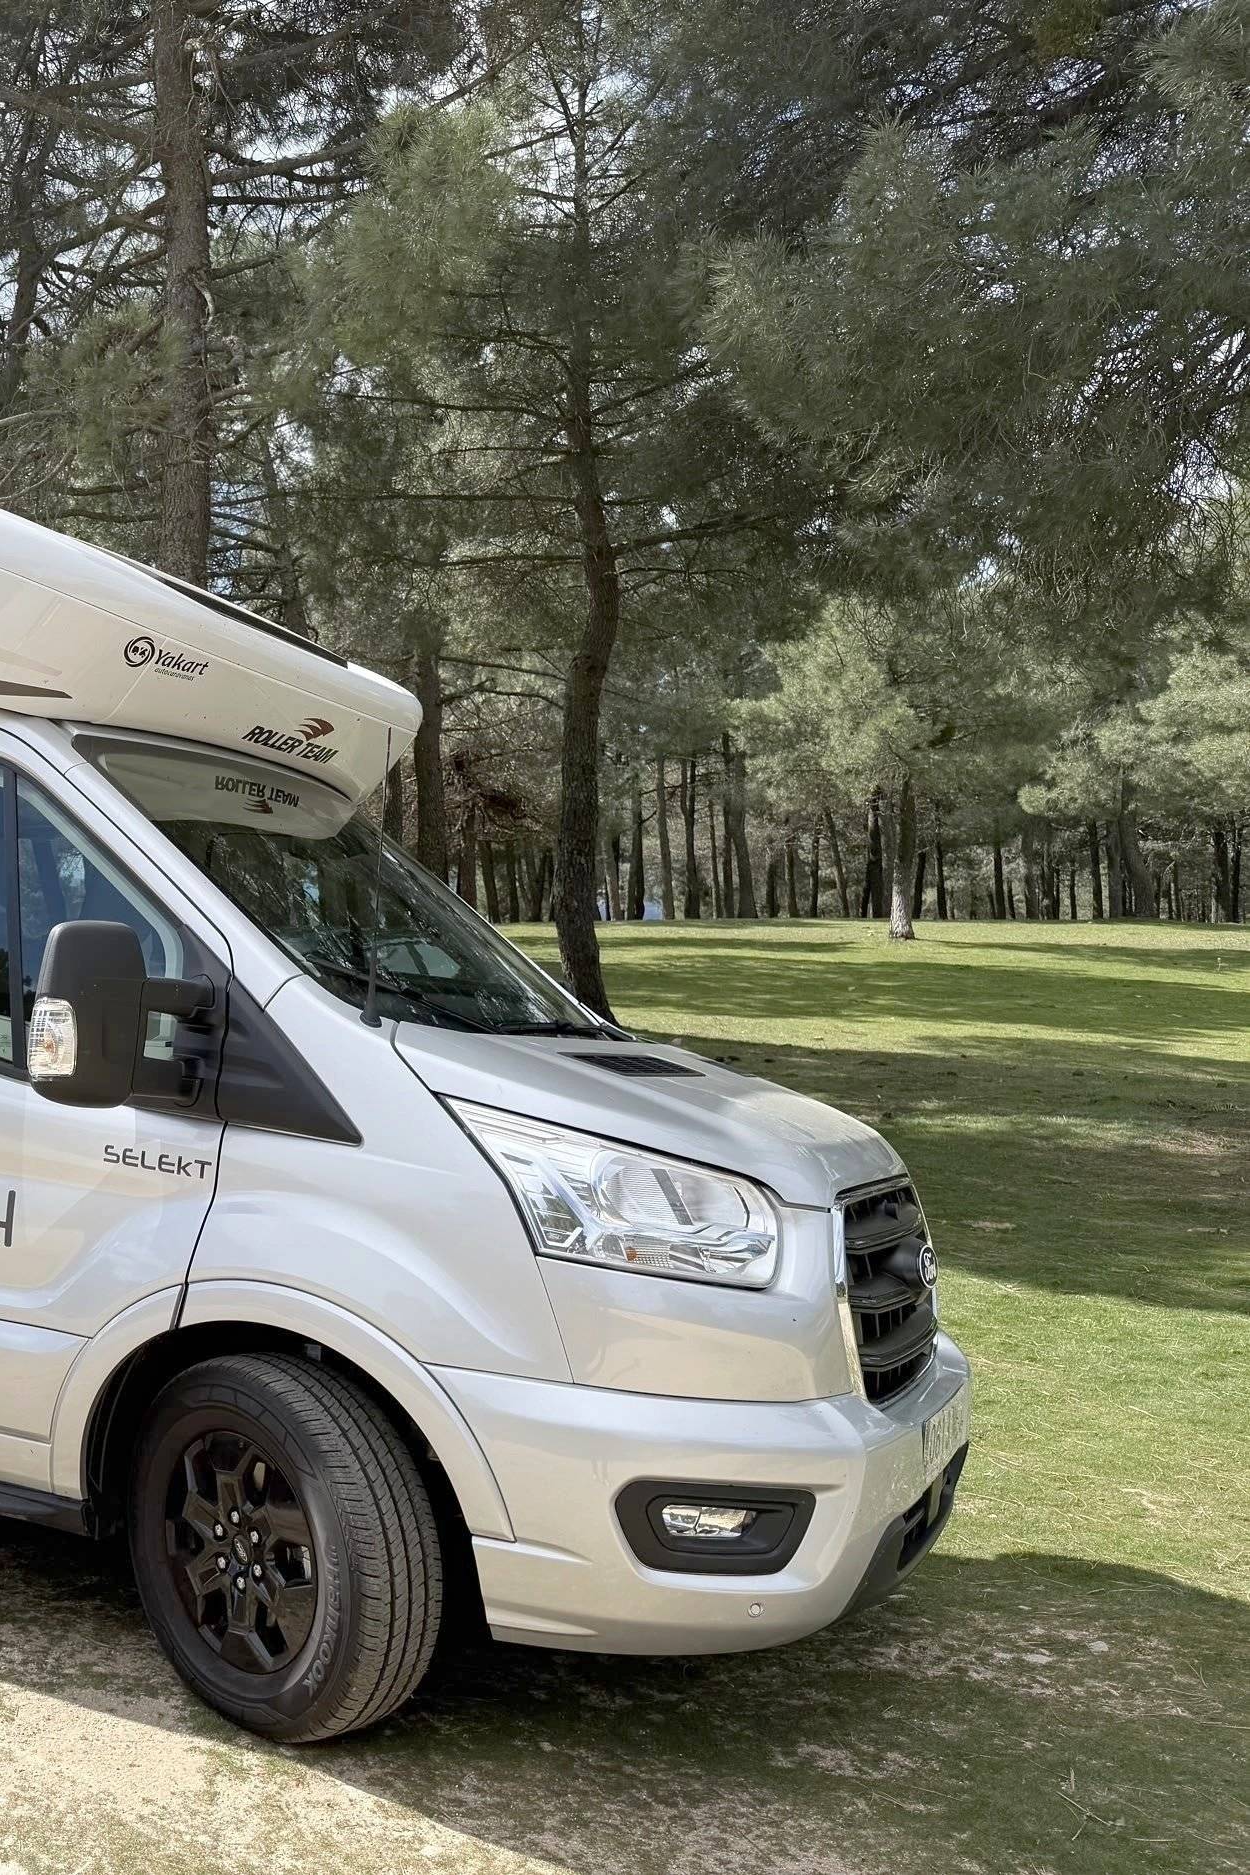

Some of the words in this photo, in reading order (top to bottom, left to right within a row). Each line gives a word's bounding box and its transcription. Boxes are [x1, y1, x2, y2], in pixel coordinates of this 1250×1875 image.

[155, 649, 209, 675] Yakart
[241, 725, 304, 754] ROLLER
[295, 742, 339, 764] TEAM
[103, 1144, 212, 1179] SELEKT
